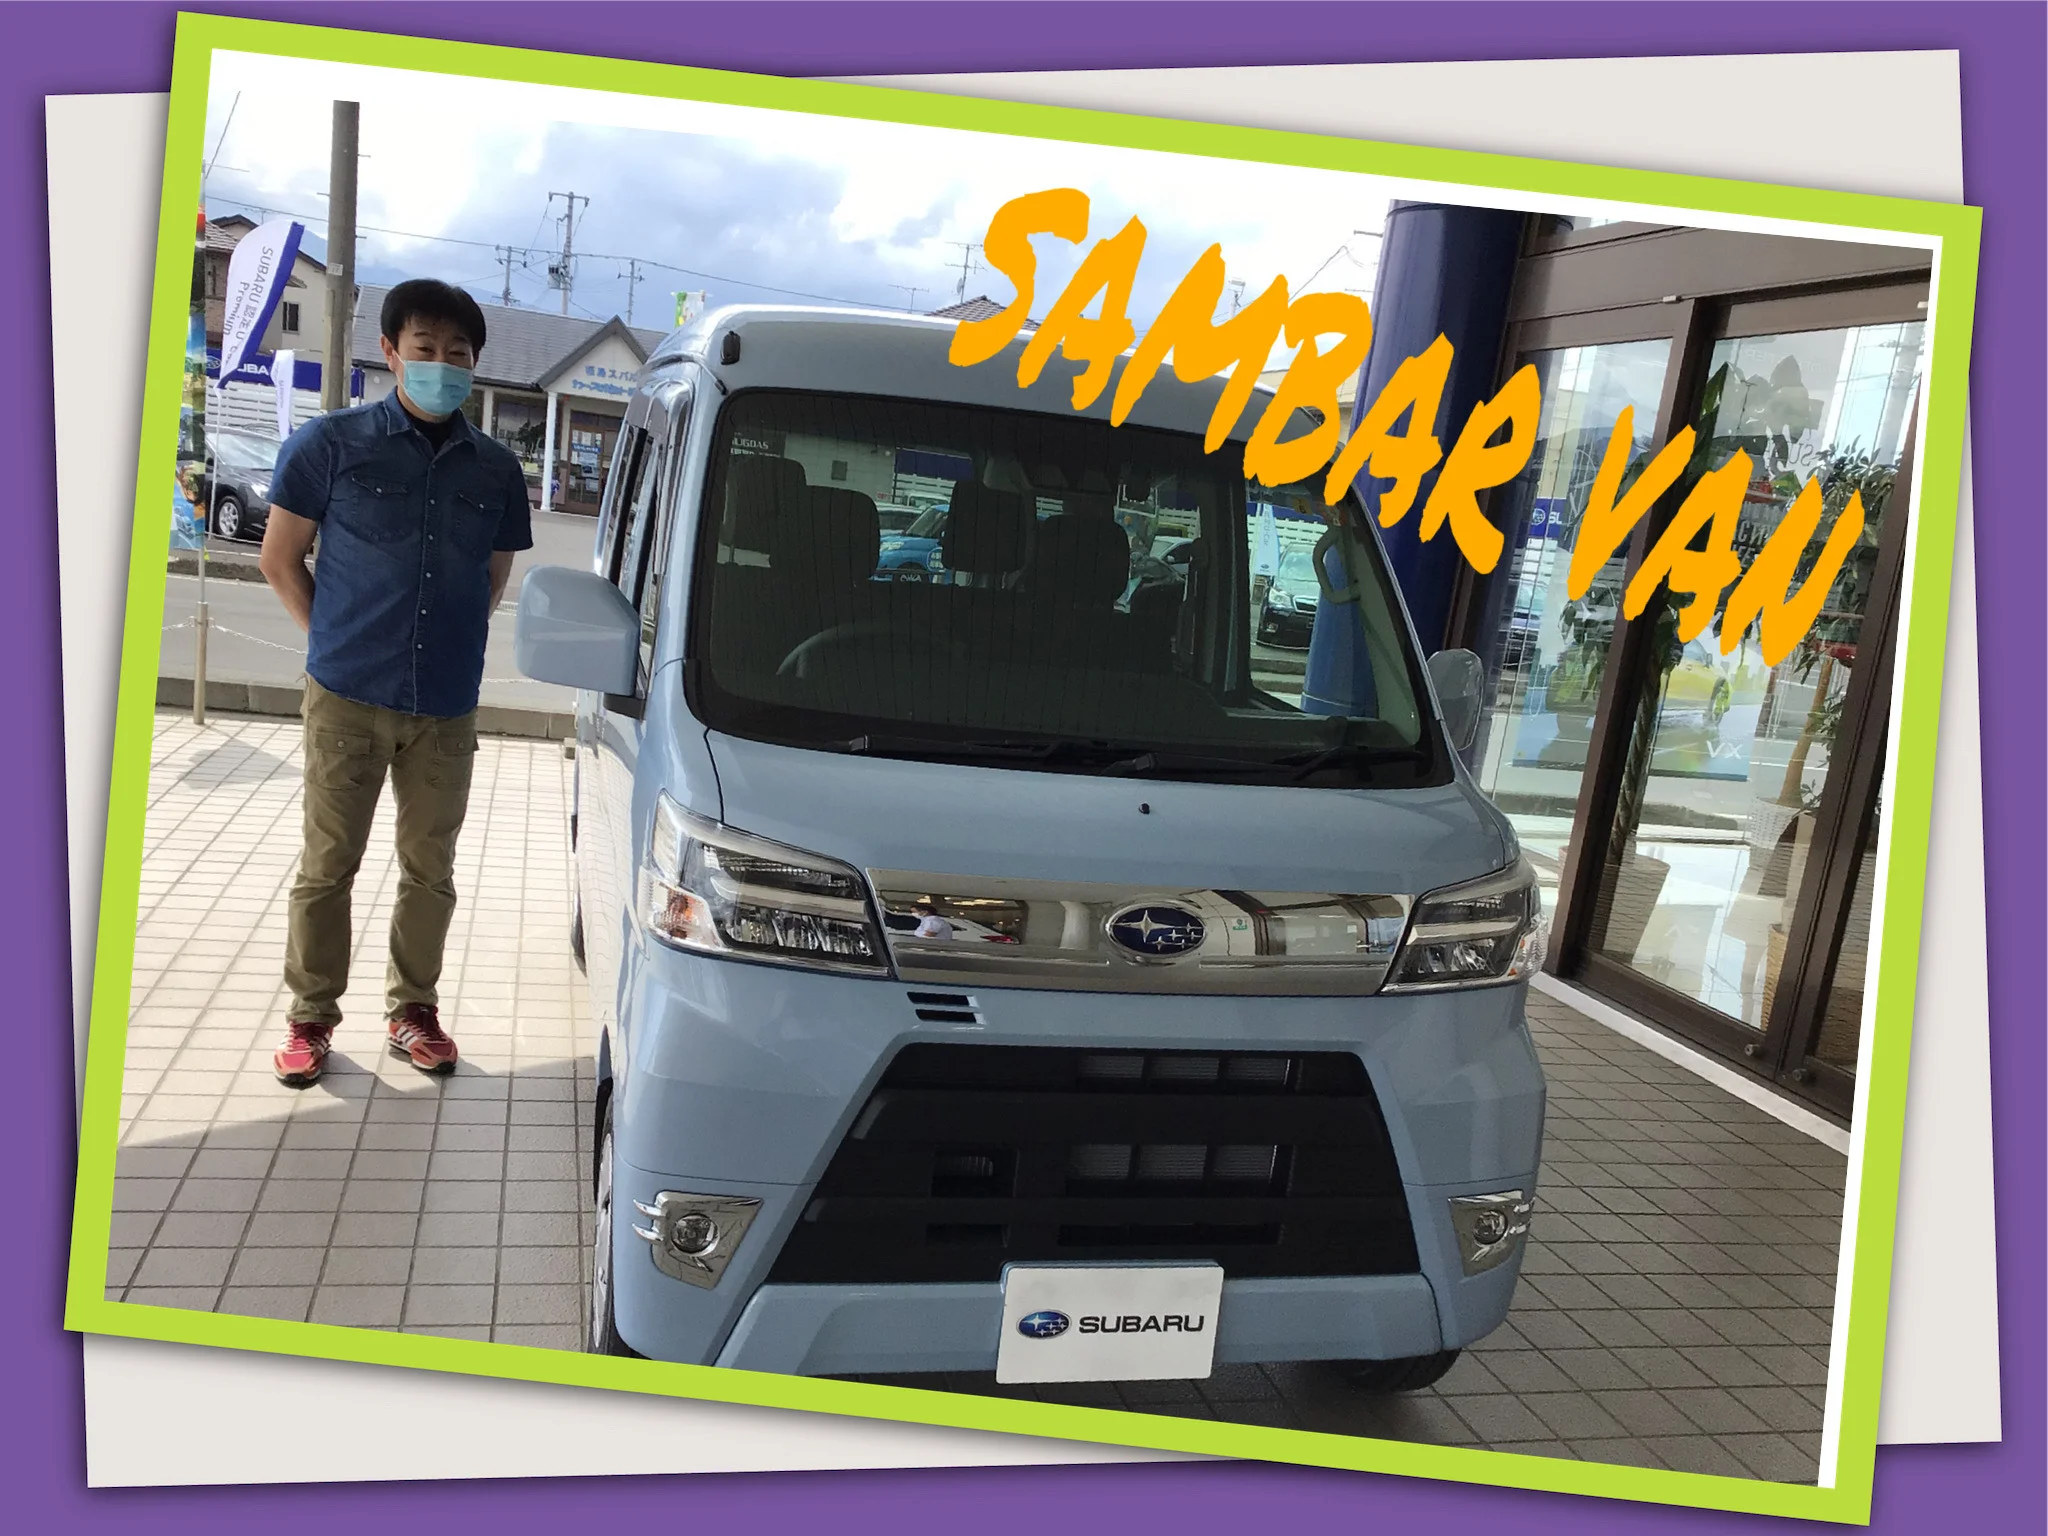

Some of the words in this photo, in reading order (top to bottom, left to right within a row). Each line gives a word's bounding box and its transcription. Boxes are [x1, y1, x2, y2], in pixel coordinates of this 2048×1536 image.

[249, 246, 274, 304] SUBARU
[223, 281, 250, 336] Premium
[1078, 1315, 1205, 1334] SUBARU
